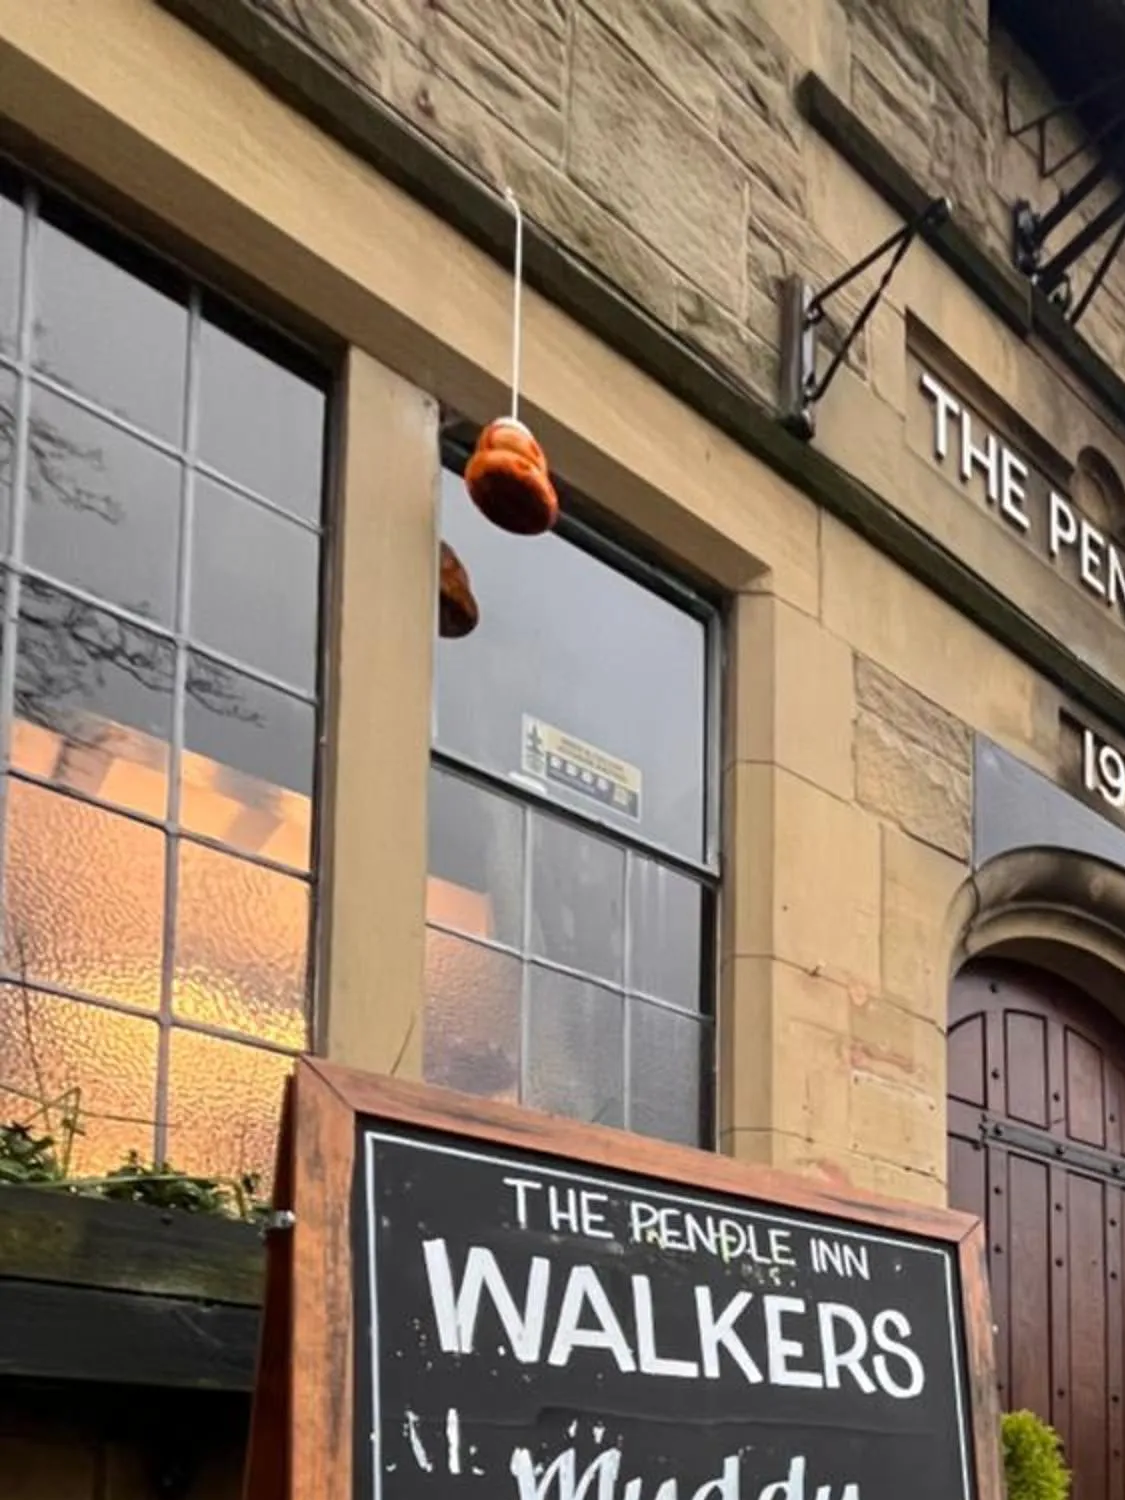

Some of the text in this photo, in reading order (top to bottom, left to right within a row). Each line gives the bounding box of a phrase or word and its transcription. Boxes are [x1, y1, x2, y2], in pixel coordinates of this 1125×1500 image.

[920, 373, 1030, 530] THE
[503, 1177, 870, 1281] THE PENDLE INN
[422, 1238, 925, 1399] WALKERS
